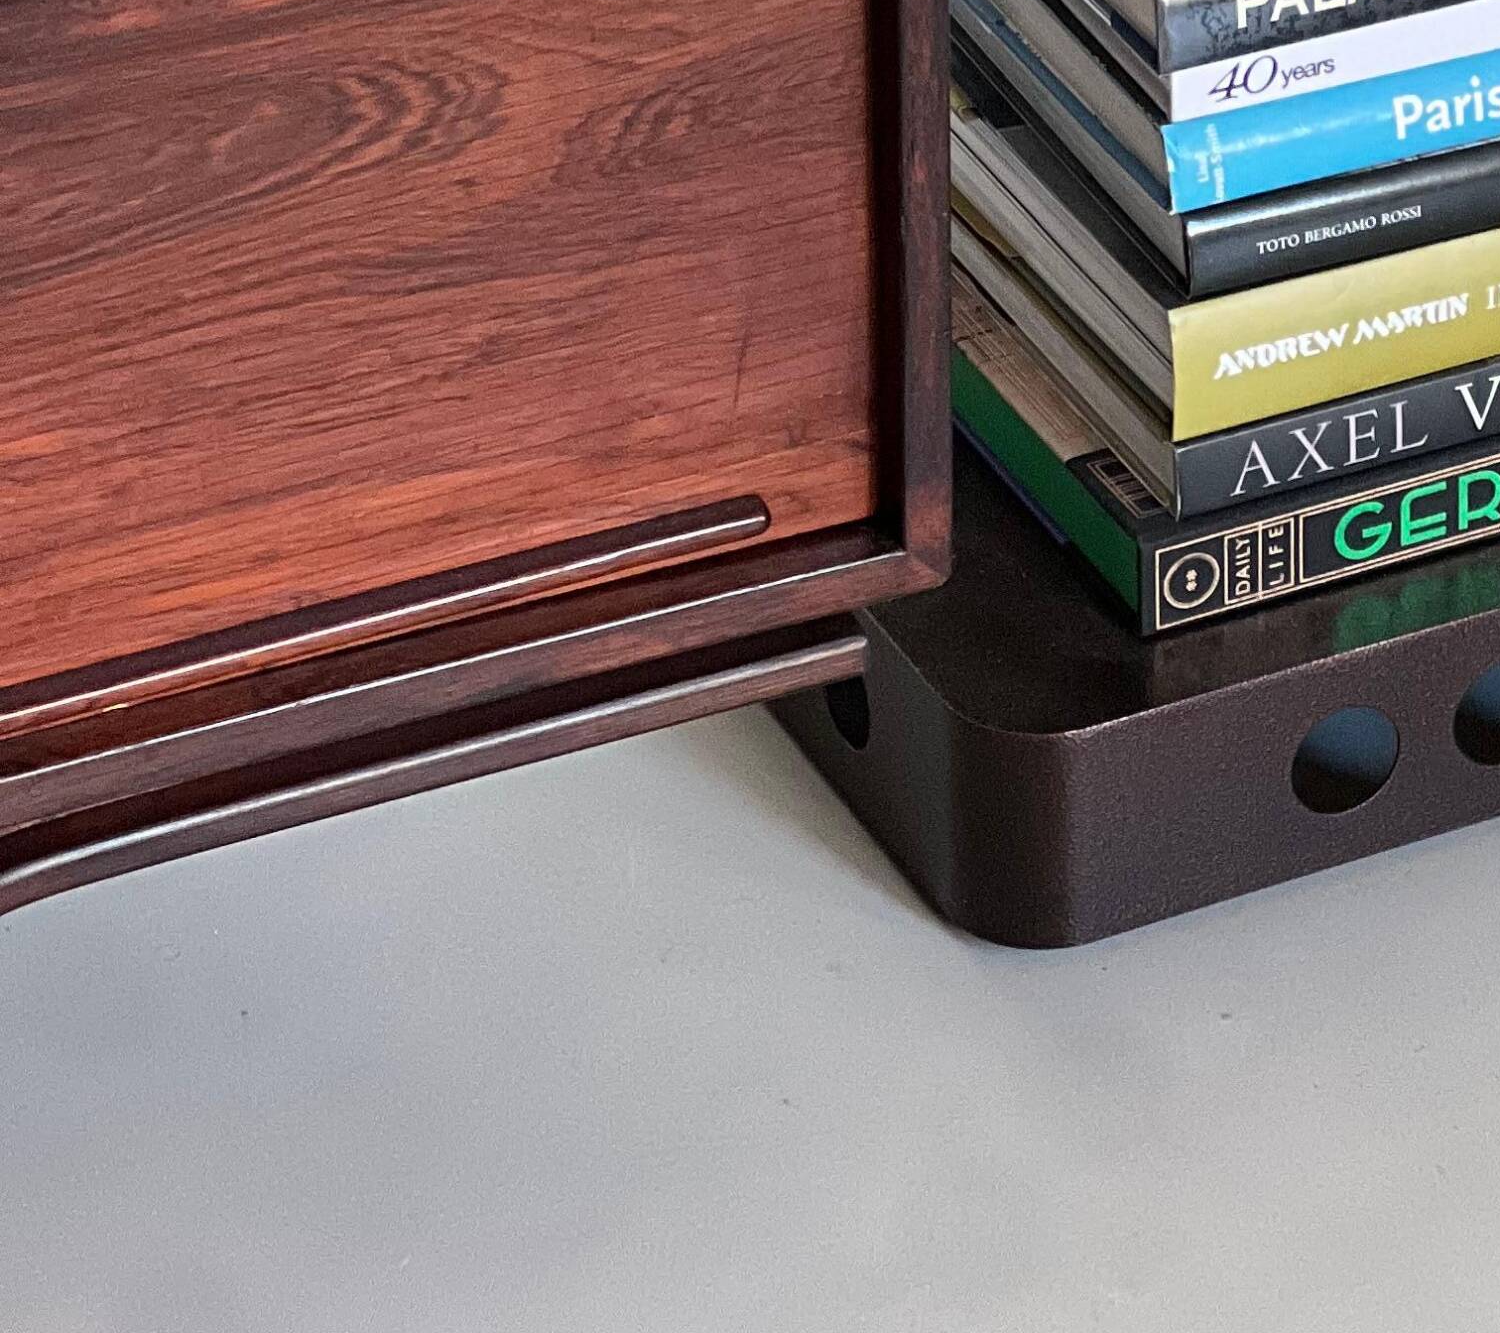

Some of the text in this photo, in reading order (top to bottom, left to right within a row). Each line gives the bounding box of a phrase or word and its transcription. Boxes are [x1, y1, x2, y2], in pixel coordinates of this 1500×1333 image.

[1207, 54, 1336, 103] 40 years
[1255, 205, 1422, 255] TOTO BERGAMO ROSSI
[1213, 322, 1350, 380] ANDREW
[1352, 292, 1470, 345] MARTIN
[1229, 400, 1429, 497] AXEL
[1235, 538, 1250, 596] DAILY
[1268, 525, 1285, 586] LIFE
